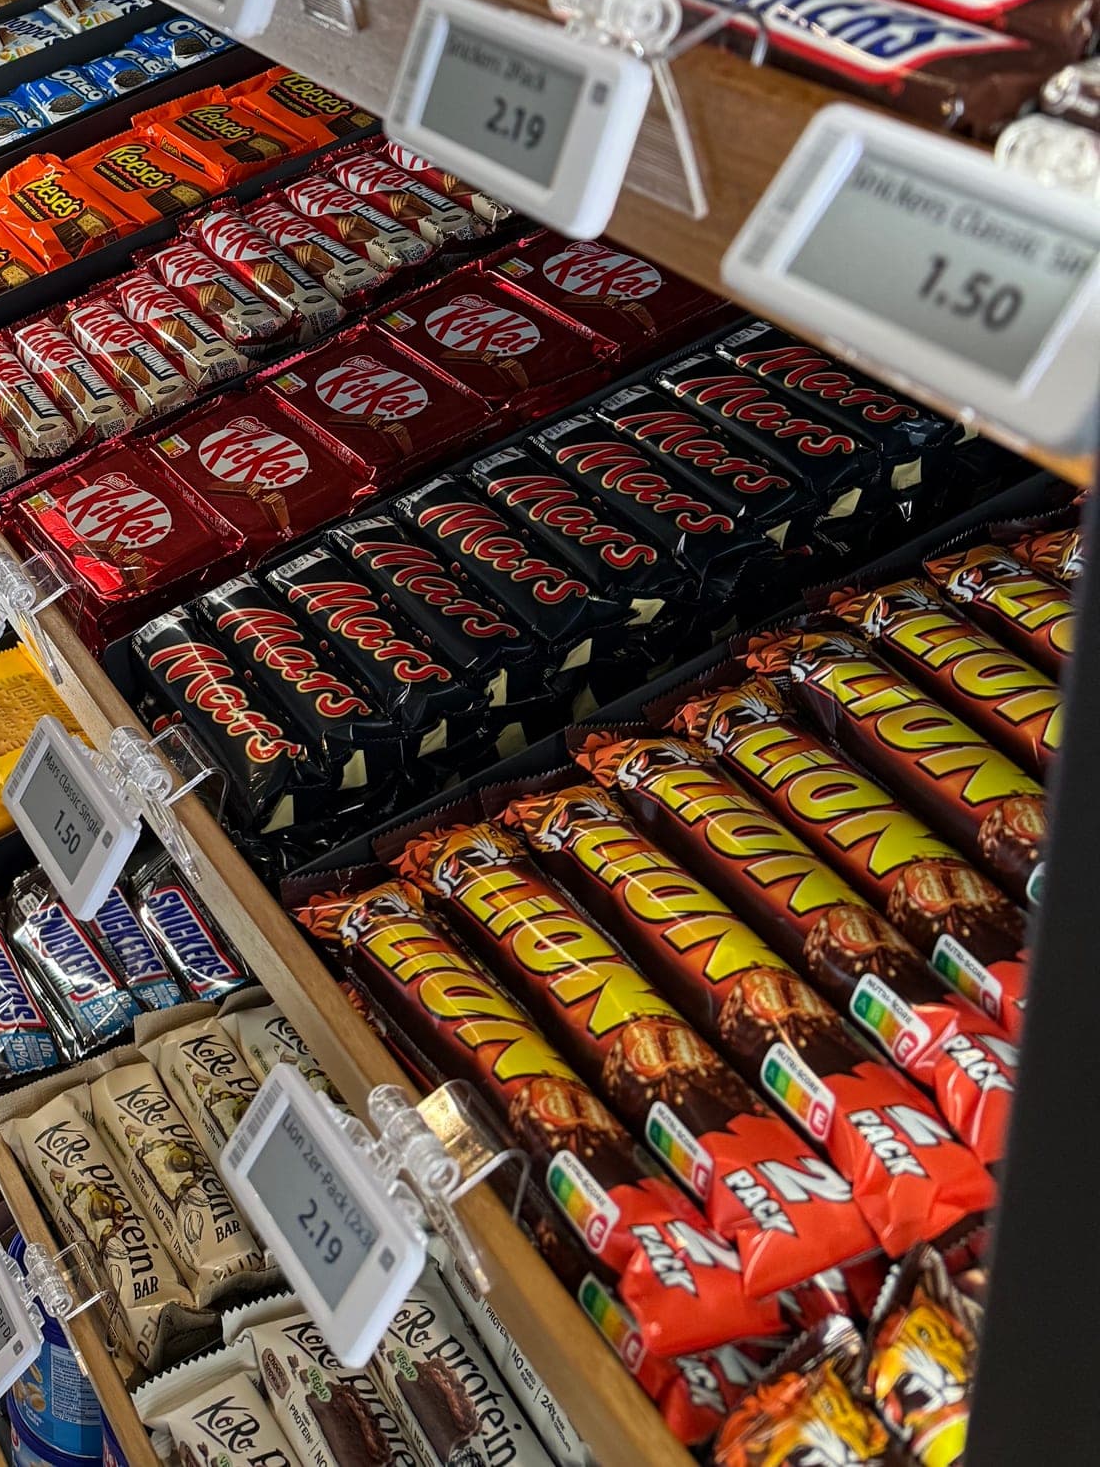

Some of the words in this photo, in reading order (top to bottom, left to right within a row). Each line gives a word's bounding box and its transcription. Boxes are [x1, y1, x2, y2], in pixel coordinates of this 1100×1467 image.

[50, 67, 103, 102] OREO
[190, 105, 253, 140] Reese's
[485, 94, 546, 150] 2.19
[104, 144, 174, 189] Reese's
[543, 250, 661, 300] KitKat
[916, 251, 1025, 333] 1.50
[426, 303, 538, 356] KitKat
[318, 366, 426, 419] KitKat
[734, 344, 917, 423] Mars
[675, 374, 855, 455] Mars
[200, 429, 307, 485] KitKat
[614, 411, 790, 494] Mars
[66, 486, 169, 546] KitKat
[555, 441, 734, 533] Mars
[487, 475, 658, 570] Mars
[418, 502, 589, 605] Mars
[351, 541, 520, 637] Mars
[287, 581, 452, 683] Mars
[216, 608, 373, 718] Mars
[148, 642, 301, 763] Mars
[805, 660, 1050, 808] LION
[42, 751, 64, 781] Mars
[58, 771, 85, 809] Classic
[75, 804, 103, 836] Single
[722, 726, 964, 879] LION
[50, 809, 82, 856] 1.50
[633, 768, 872, 916] LION
[563, 825, 788, 985] LION
[450, 869, 688, 1039] LION
[361, 921, 583, 1085] LION
[866, 977, 914, 1025] NUTRI-SCORE
[8, 1034, 30, 1067] 30%
[178, 1033, 238, 1077] KoRo
[775, 1047, 821, 1095] NUTRI-SCORE
[941, 1033, 1016, 1094] PACK
[114, 1083, 172, 1128] KoRo
[282, 1113, 305, 1151] Lion
[657, 1105, 699, 1159] NUTRI-SCORE
[35, 1120, 91, 1169] KoRo
[848, 1108, 931, 1179] PACK
[561, 1154, 608, 1209] NUTRI-SCORE
[722, 1167, 799, 1238] PACK
[753, 1154, 854, 1203] 2
[215, 1219, 242, 1244] BAR
[297, 1197, 343, 1265] 2.19
[132, 1276, 159, 1301] BAR
[308, 1368, 329, 1401] VEGAN
[395, 1350, 417, 1379] VEGAN
[511, 1347, 525, 1370] NO
[192, 1395, 260, 1455] KoRo
[288, 1403, 314, 1445] PROTEIN
[423, 1333, 519, 1465] protein
